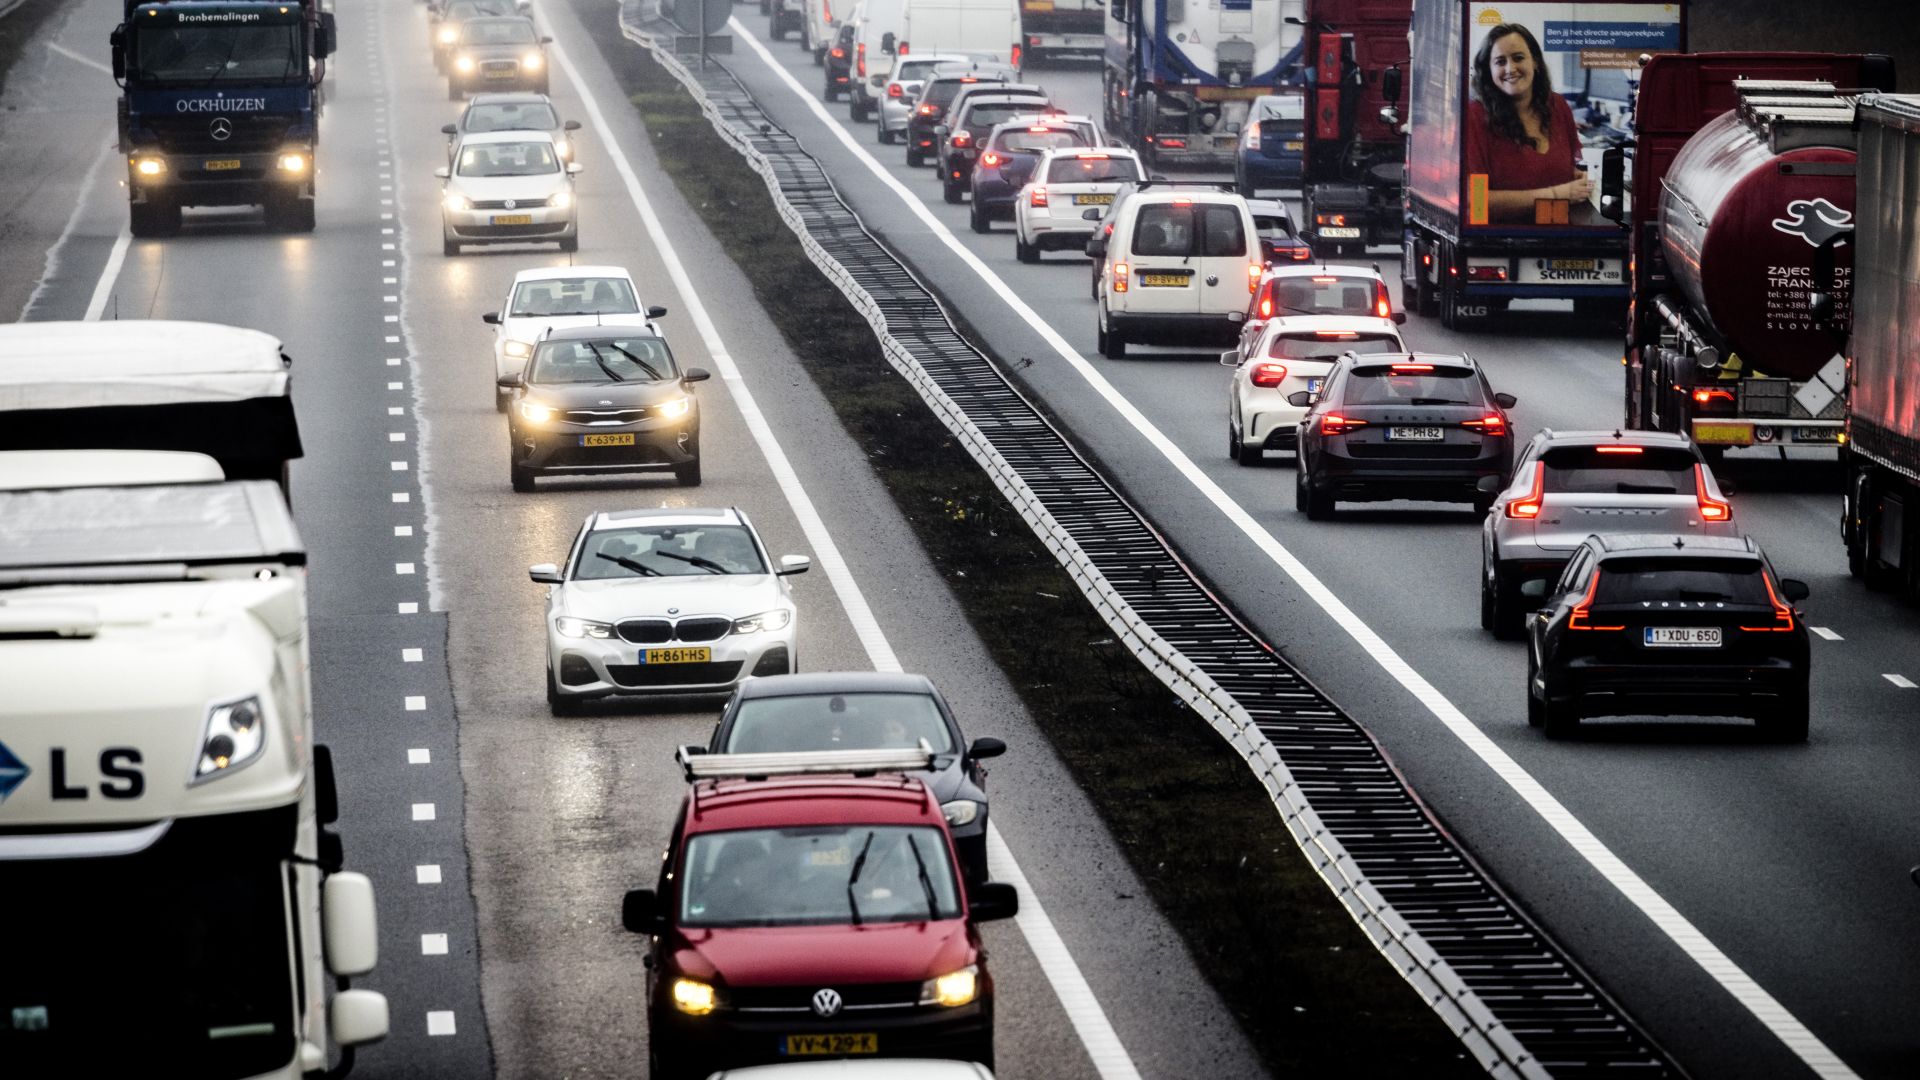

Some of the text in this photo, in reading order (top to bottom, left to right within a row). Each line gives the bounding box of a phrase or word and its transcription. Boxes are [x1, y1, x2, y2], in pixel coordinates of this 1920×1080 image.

[178, 12, 260, 23] Bronbemalingen
[1547, 28, 1562, 36] Ben
[1570, 28, 1583, 36] het
[1583, 28, 1609, 36] directe
[1609, 29, 1665, 38] aanspreekpunt
[176, 98, 265, 112] OCKHUIZEN
[1540, 270, 1601, 280] SCHMITZ
[1767, 266, 1810, 278] ZAJEC
[1767, 291, 1782, 299] tel:
[1784, 291, 1805, 299] +386
[1767, 301, 1783, 309] fax:
[1456, 306, 1488, 317] KLG
[586, 435, 632, 446] K-639-KR
[650, 649, 706, 662] H-861-HS
[50, 746, 145, 801] LS
